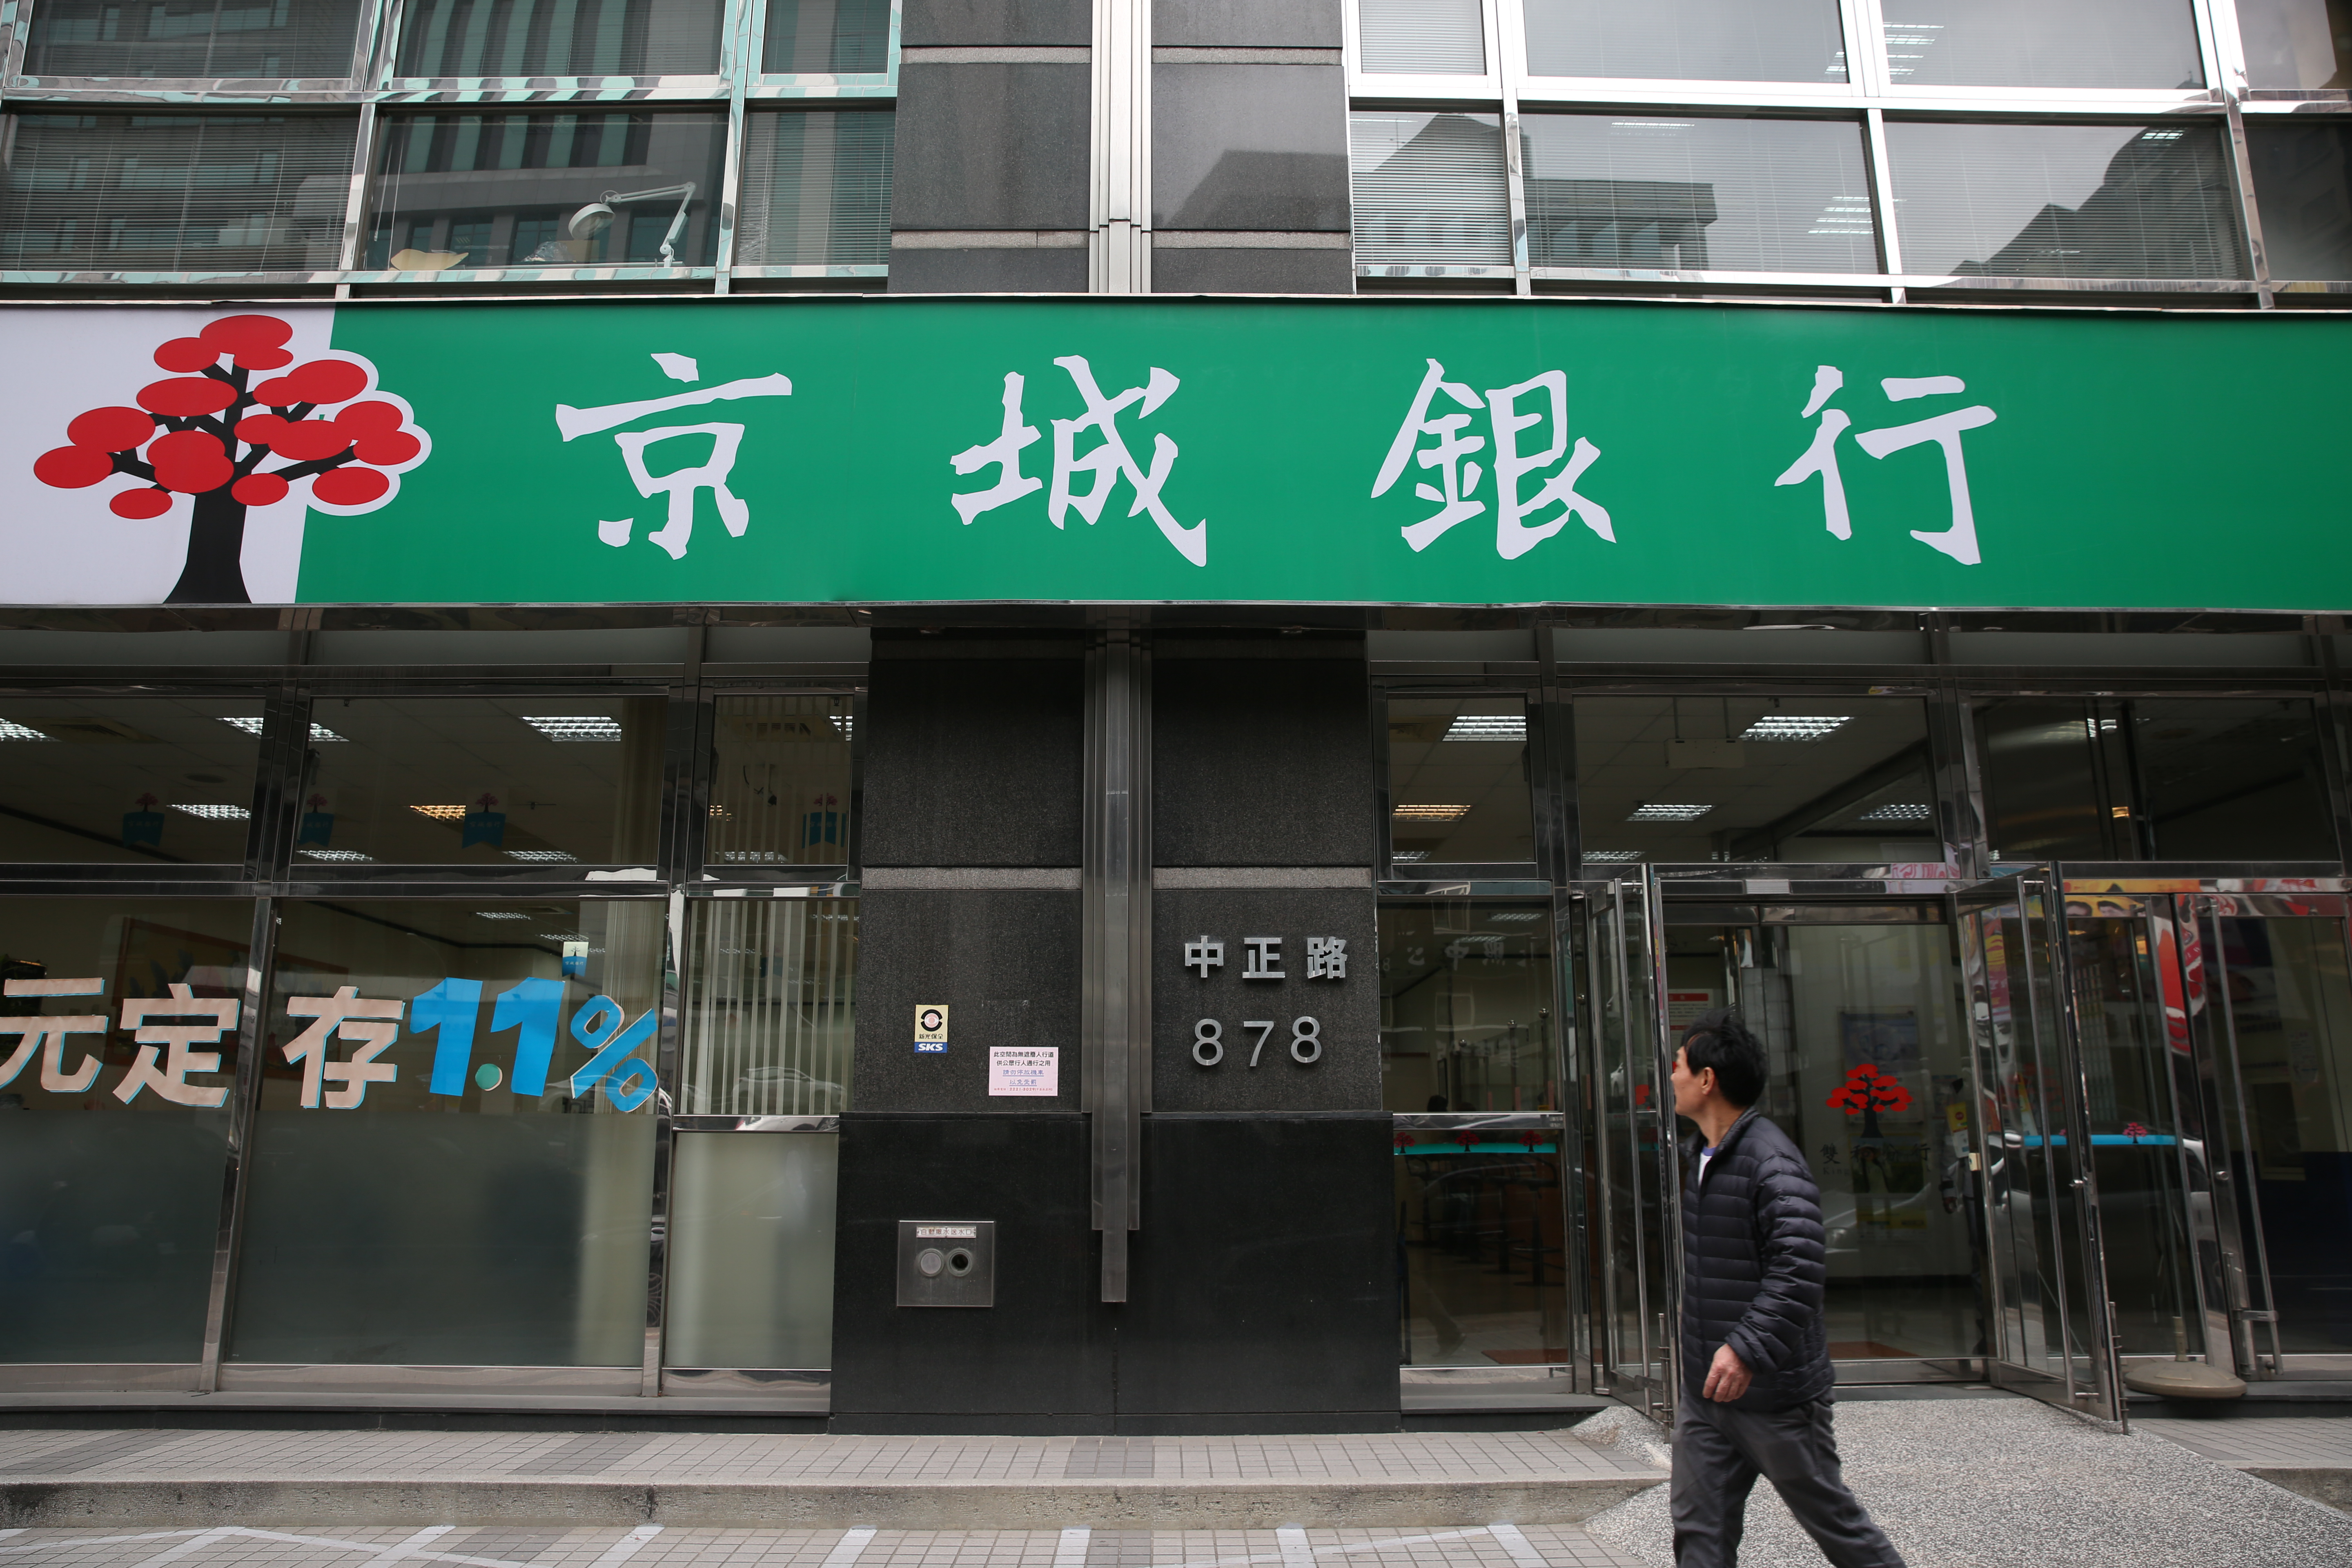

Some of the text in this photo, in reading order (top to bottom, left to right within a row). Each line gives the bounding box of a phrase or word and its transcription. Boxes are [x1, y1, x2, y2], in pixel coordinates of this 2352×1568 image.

[556, 353, 1997, 567] 京城銀行
[1185, 935, 1348, 979] 中正路
[918, 1043, 943, 1051] SKS
[1192, 1016, 1322, 1067] 878
